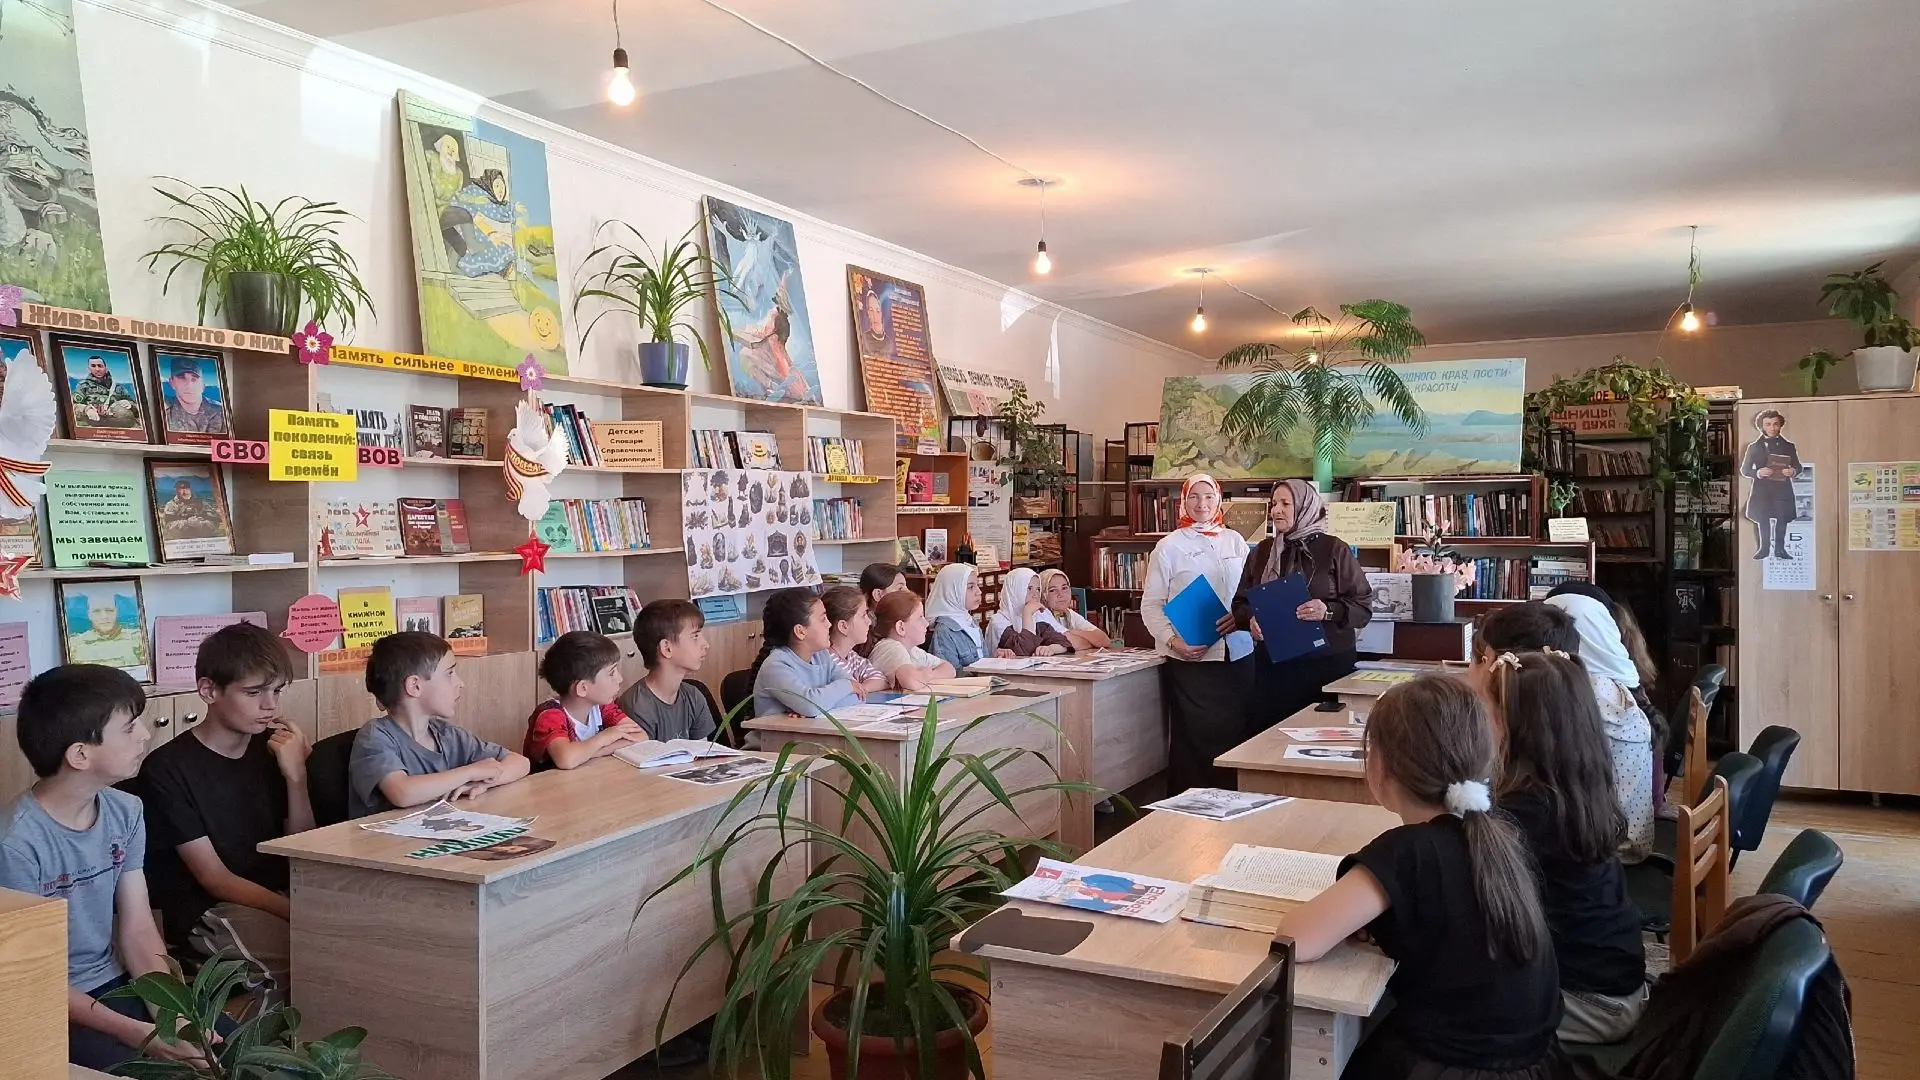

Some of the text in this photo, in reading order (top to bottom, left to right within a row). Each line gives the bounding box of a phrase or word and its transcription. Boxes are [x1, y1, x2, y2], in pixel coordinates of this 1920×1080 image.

[29, 305, 285, 353] Живые, помните о них
[393, 355, 454, 371] сильнее
[463, 364, 519, 379] времени
[1415, 382, 1458, 393] КРАСОТУ
[287, 414, 339, 428] Память
[273, 429, 356, 445] поколений:
[216, 442, 265, 461] СВО
[291, 448, 333, 461] связь
[359, 449, 400, 465] ВОВ
[285, 463, 339, 478] времён
[80, 535, 143, 546] завещаем
[1789, 532, 1803, 541] Б
[71, 551, 135, 560] помнить...
[348, 609, 385, 618] КНИЖНОЙ
[347, 630, 393, 639] МГНОВЕНИЯ
